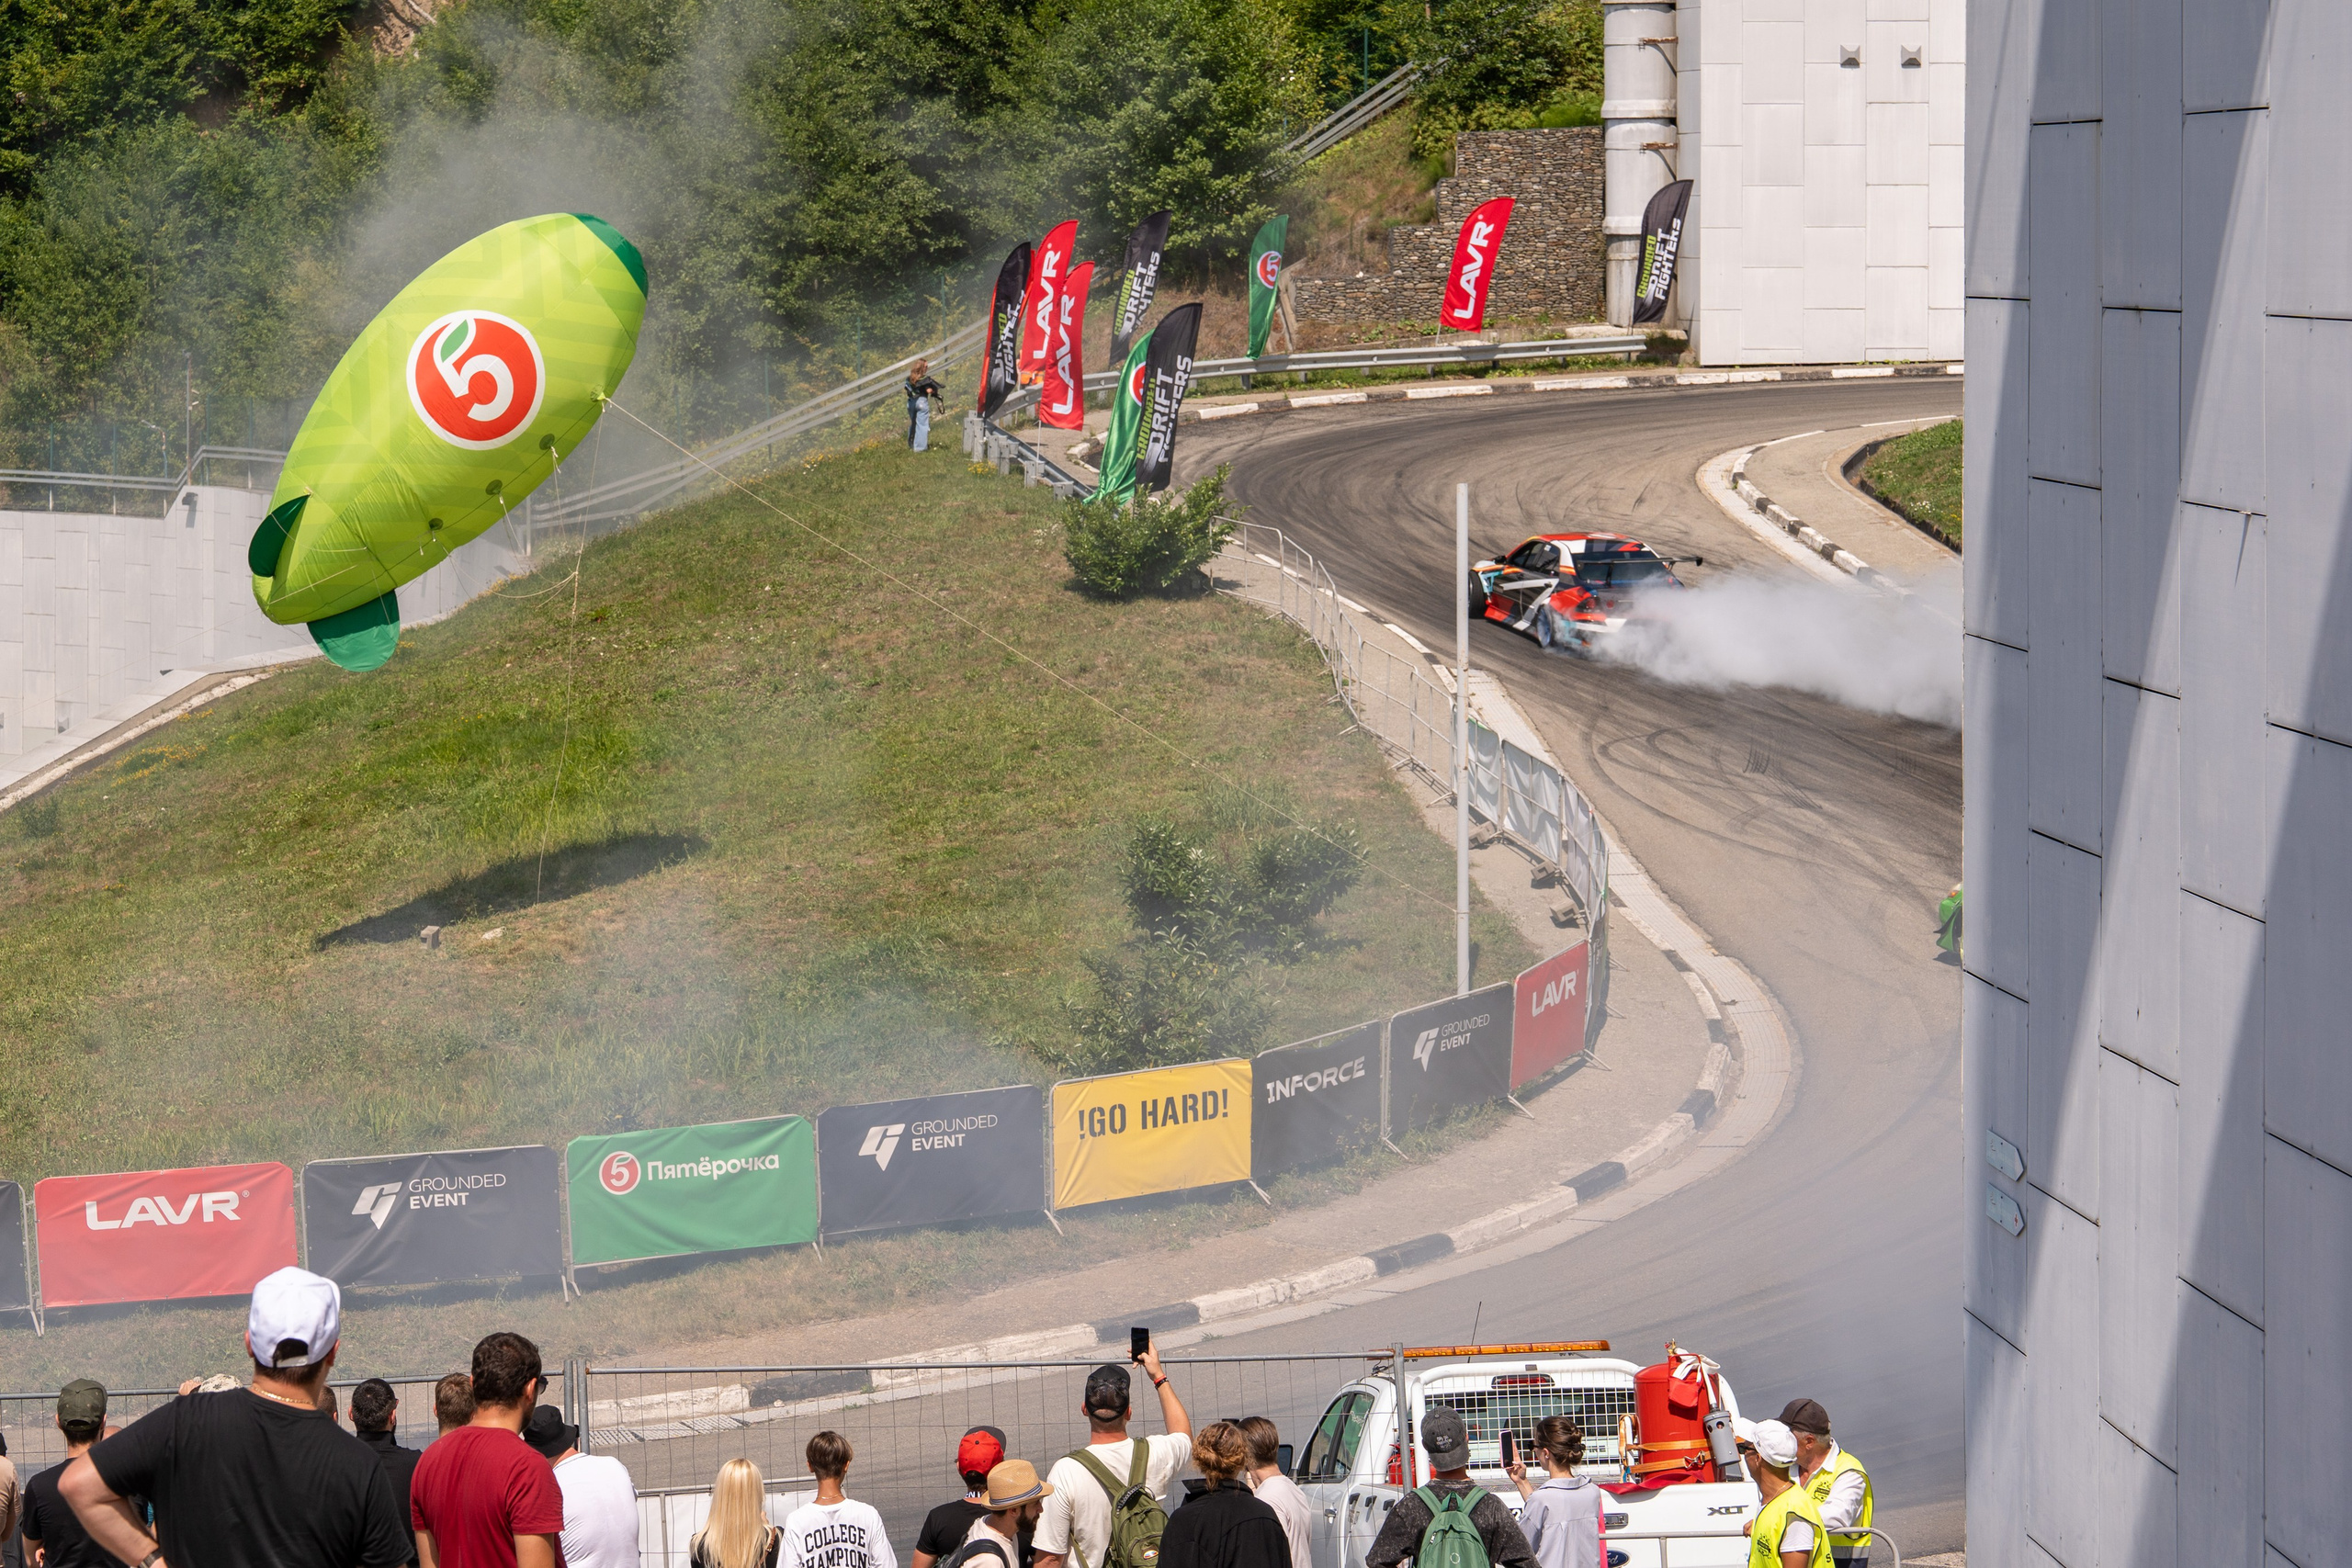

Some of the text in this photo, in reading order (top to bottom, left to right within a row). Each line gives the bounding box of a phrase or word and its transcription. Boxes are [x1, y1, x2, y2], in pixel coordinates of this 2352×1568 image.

[1453, 220, 1495, 320] LAVR
[1636, 234, 1657, 299] GROUNDED
[1644, 228, 1671, 307] DRIFT
[1654, 217, 1681, 300] FIGHTERS
[1033, 250, 1061, 359] LAVR
[1114, 268, 1136, 335] GROUNDED
[1118, 261, 1148, 342] DRIFT
[1052, 293, 1076, 415] LAVR
[1143, 367, 1174, 473] DRIFT
[1532, 970, 1577, 1018] LAVR
[1440, 1032, 1472, 1054] EVENT
[1441, 1013, 1490, 1037] GROUNDED
[1266, 1055, 1366, 1105] INFORCE
[910, 1114, 999, 1134] GROUNDED
[1079, 1089, 1230, 1141] !GO HARD!
[911, 1133, 966, 1152] EVENT
[408, 1173, 507, 1193] GROUNDED
[647, 1154, 780, 1181] Пятёрочка
[85, 1190, 242, 1231] LAVR
[409, 1192, 469, 1210] EVENT
[1706, 1505, 1749, 1517] XLT
[801, 1547, 872, 1568] HAMPION
[804, 1523, 865, 1554] COLLEGE
